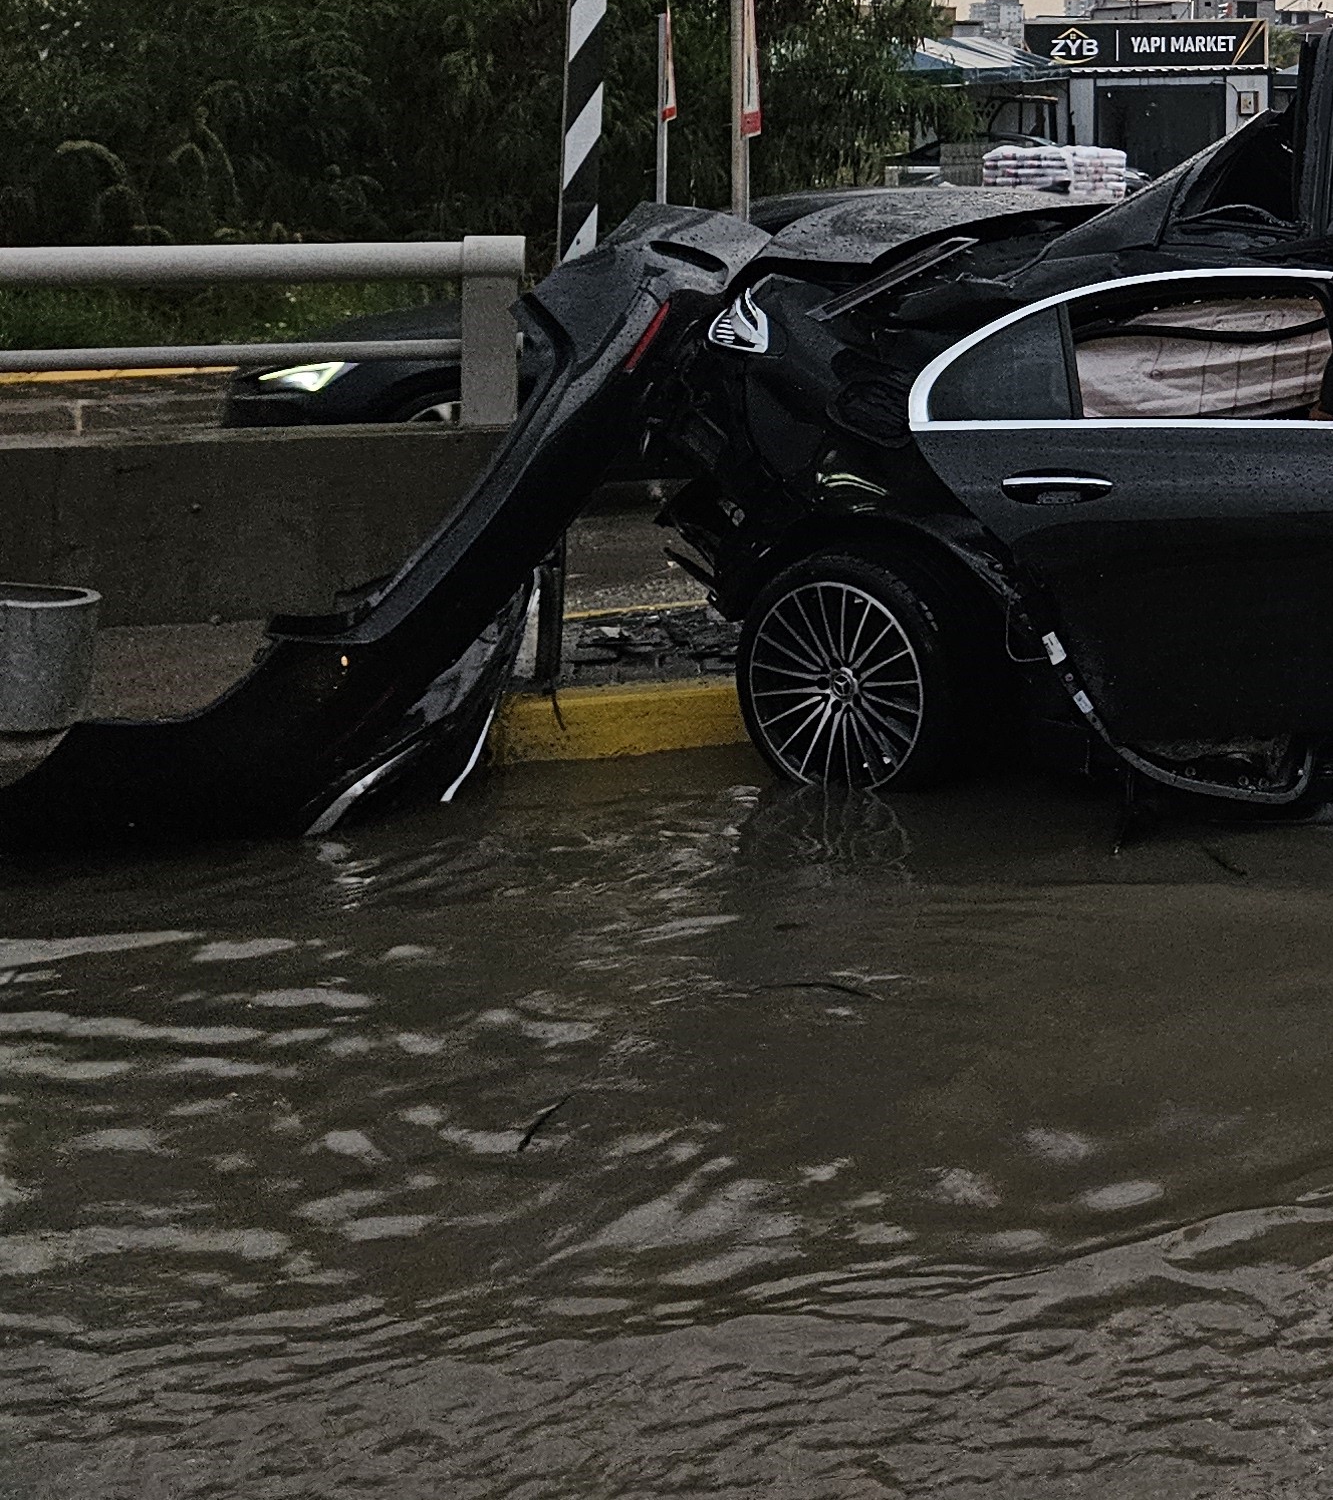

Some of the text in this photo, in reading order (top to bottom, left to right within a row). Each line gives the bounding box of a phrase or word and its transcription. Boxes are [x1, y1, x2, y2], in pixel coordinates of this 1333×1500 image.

[1050, 39, 1099, 56] ZYB
[1130, 35, 1237, 53] YAPI MARKET
